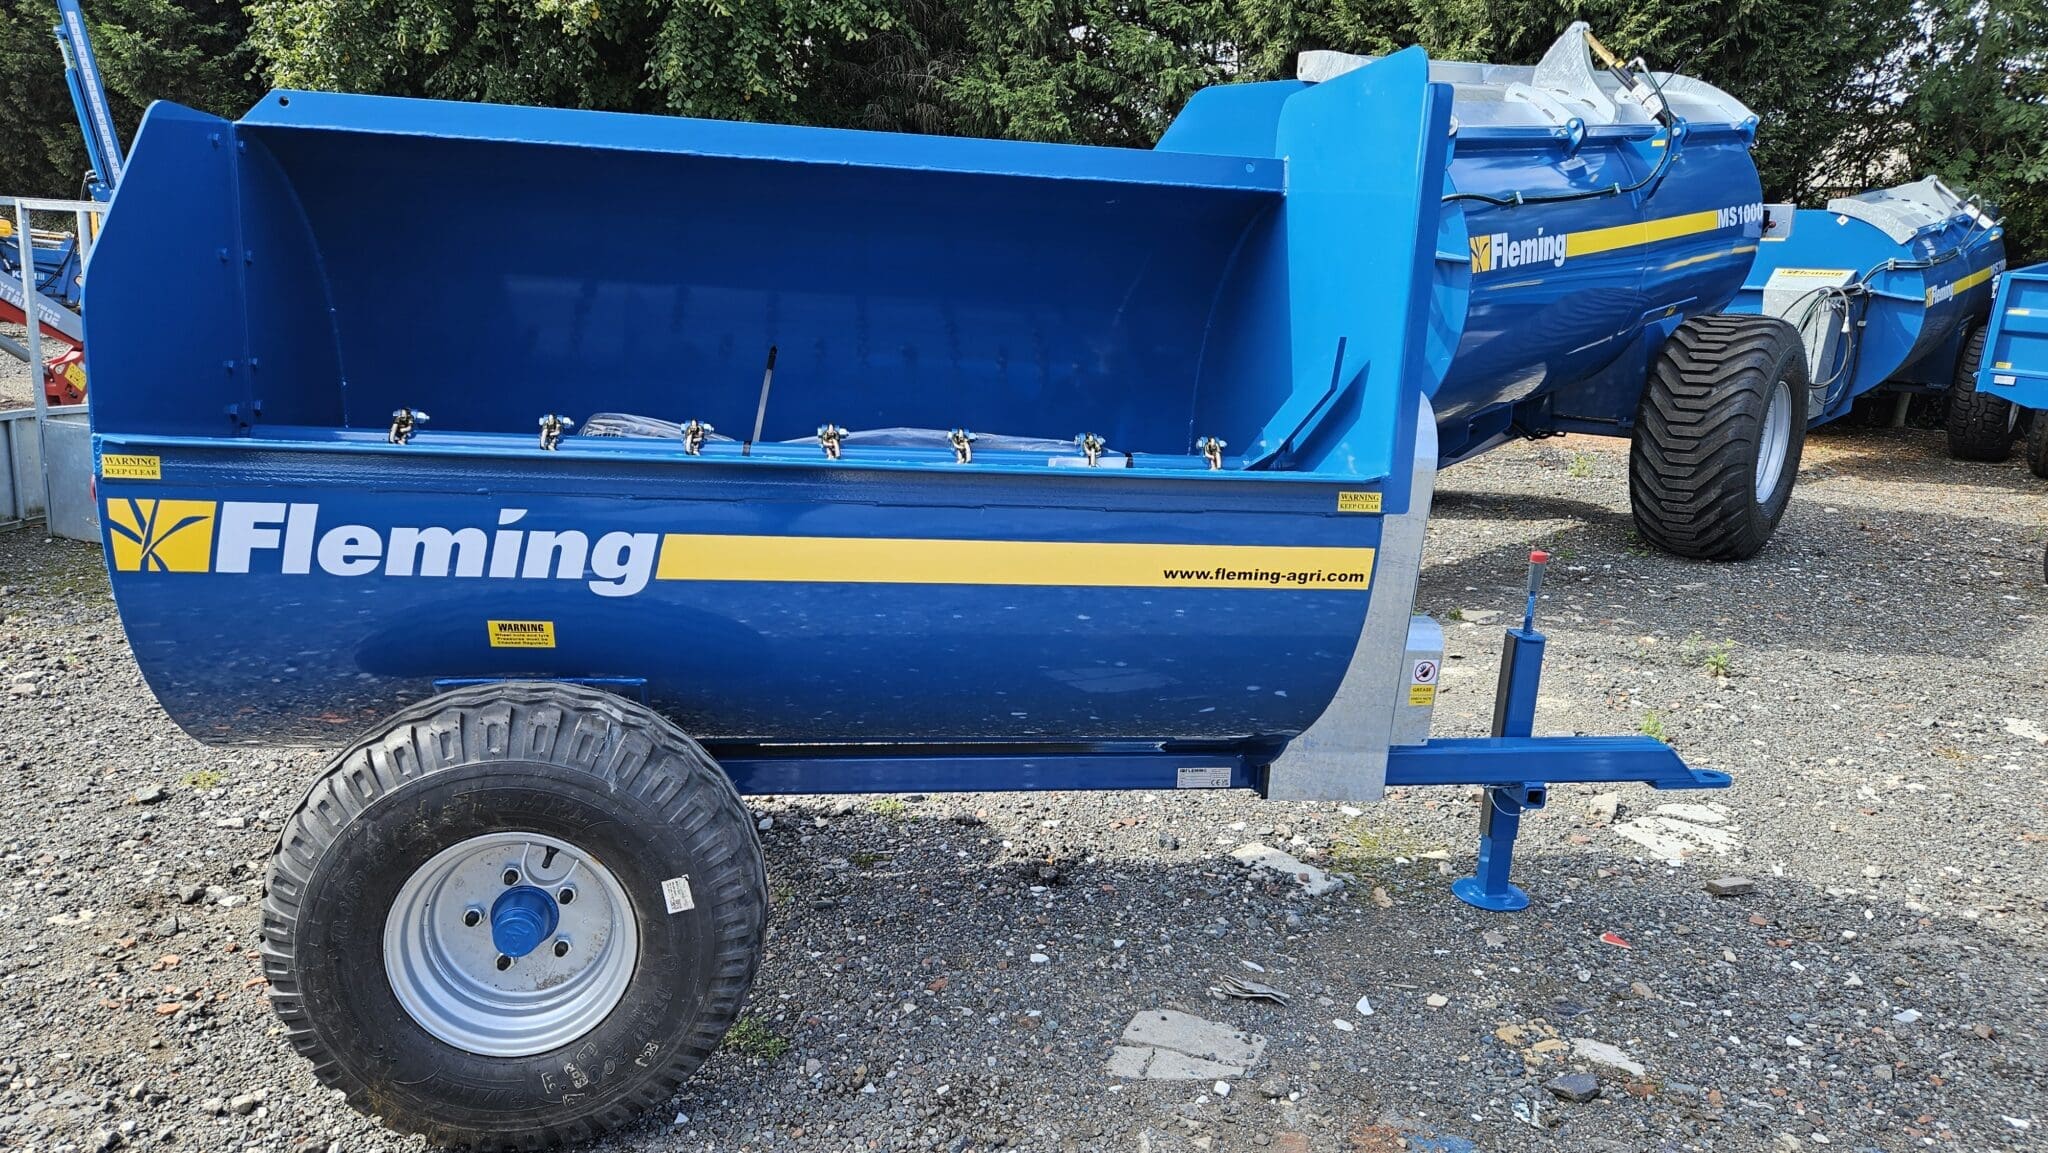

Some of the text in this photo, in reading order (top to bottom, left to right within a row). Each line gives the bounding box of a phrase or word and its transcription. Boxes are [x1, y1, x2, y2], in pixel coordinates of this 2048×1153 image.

[1717, 202, 1763, 229] MS1000
[1490, 227, 1567, 268] Fleming
[104, 456, 156, 466] WARNING
[128, 468, 157, 476] CLEAR
[1340, 493, 1379, 501] WARNING
[215, 500, 659, 598] Fleming
[1163, 568, 1365, 584] www.fleming-agri.com
[497, 623, 545, 632] WARNING
